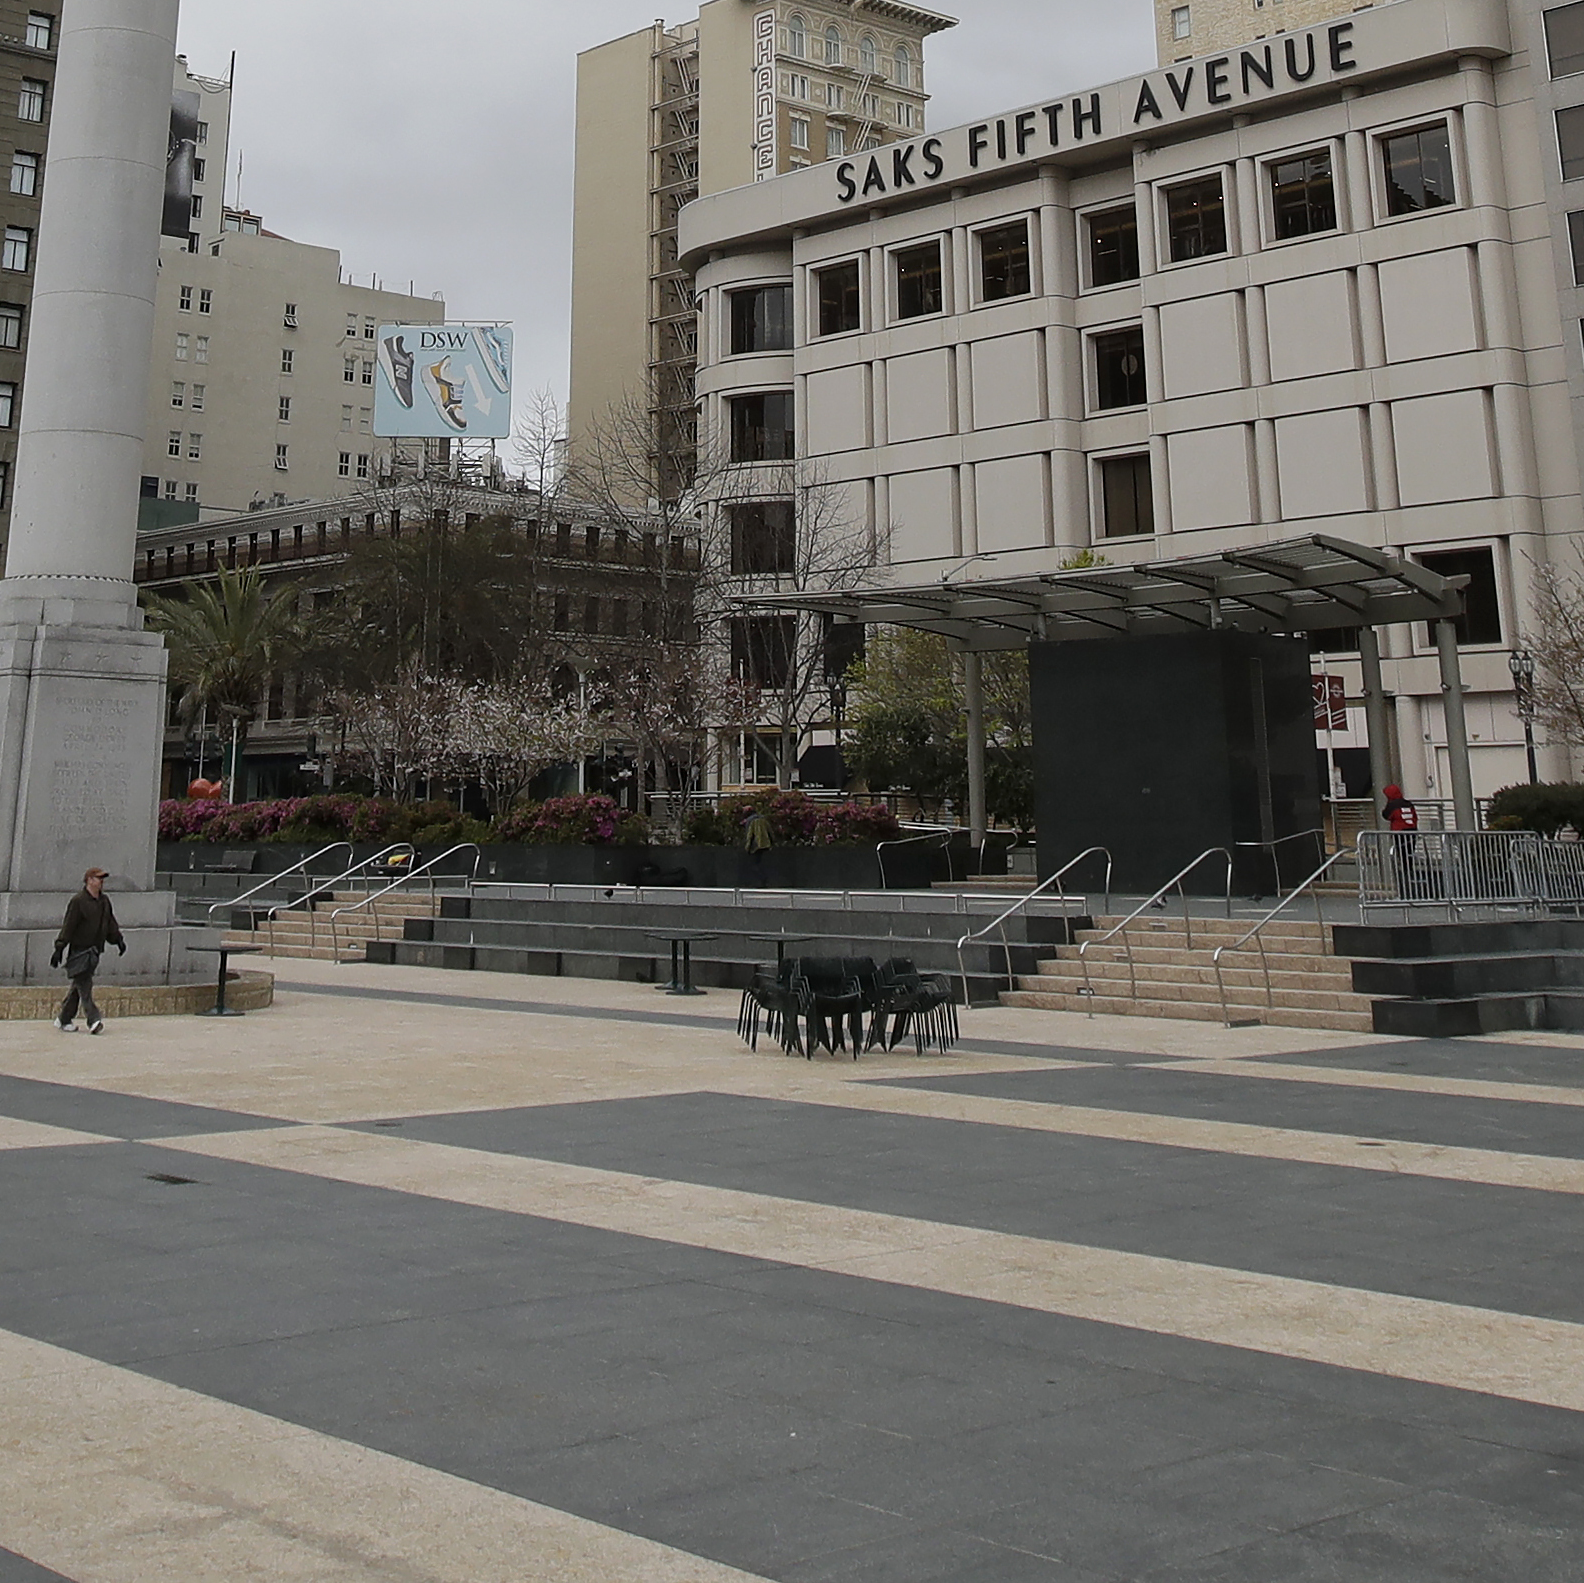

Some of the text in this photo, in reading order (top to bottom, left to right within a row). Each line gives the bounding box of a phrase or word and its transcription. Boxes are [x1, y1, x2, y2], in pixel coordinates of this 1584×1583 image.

[835, 22, 1357, 203] SAKS FIFTH AVENUE
[420, 331, 468, 348] DSW
